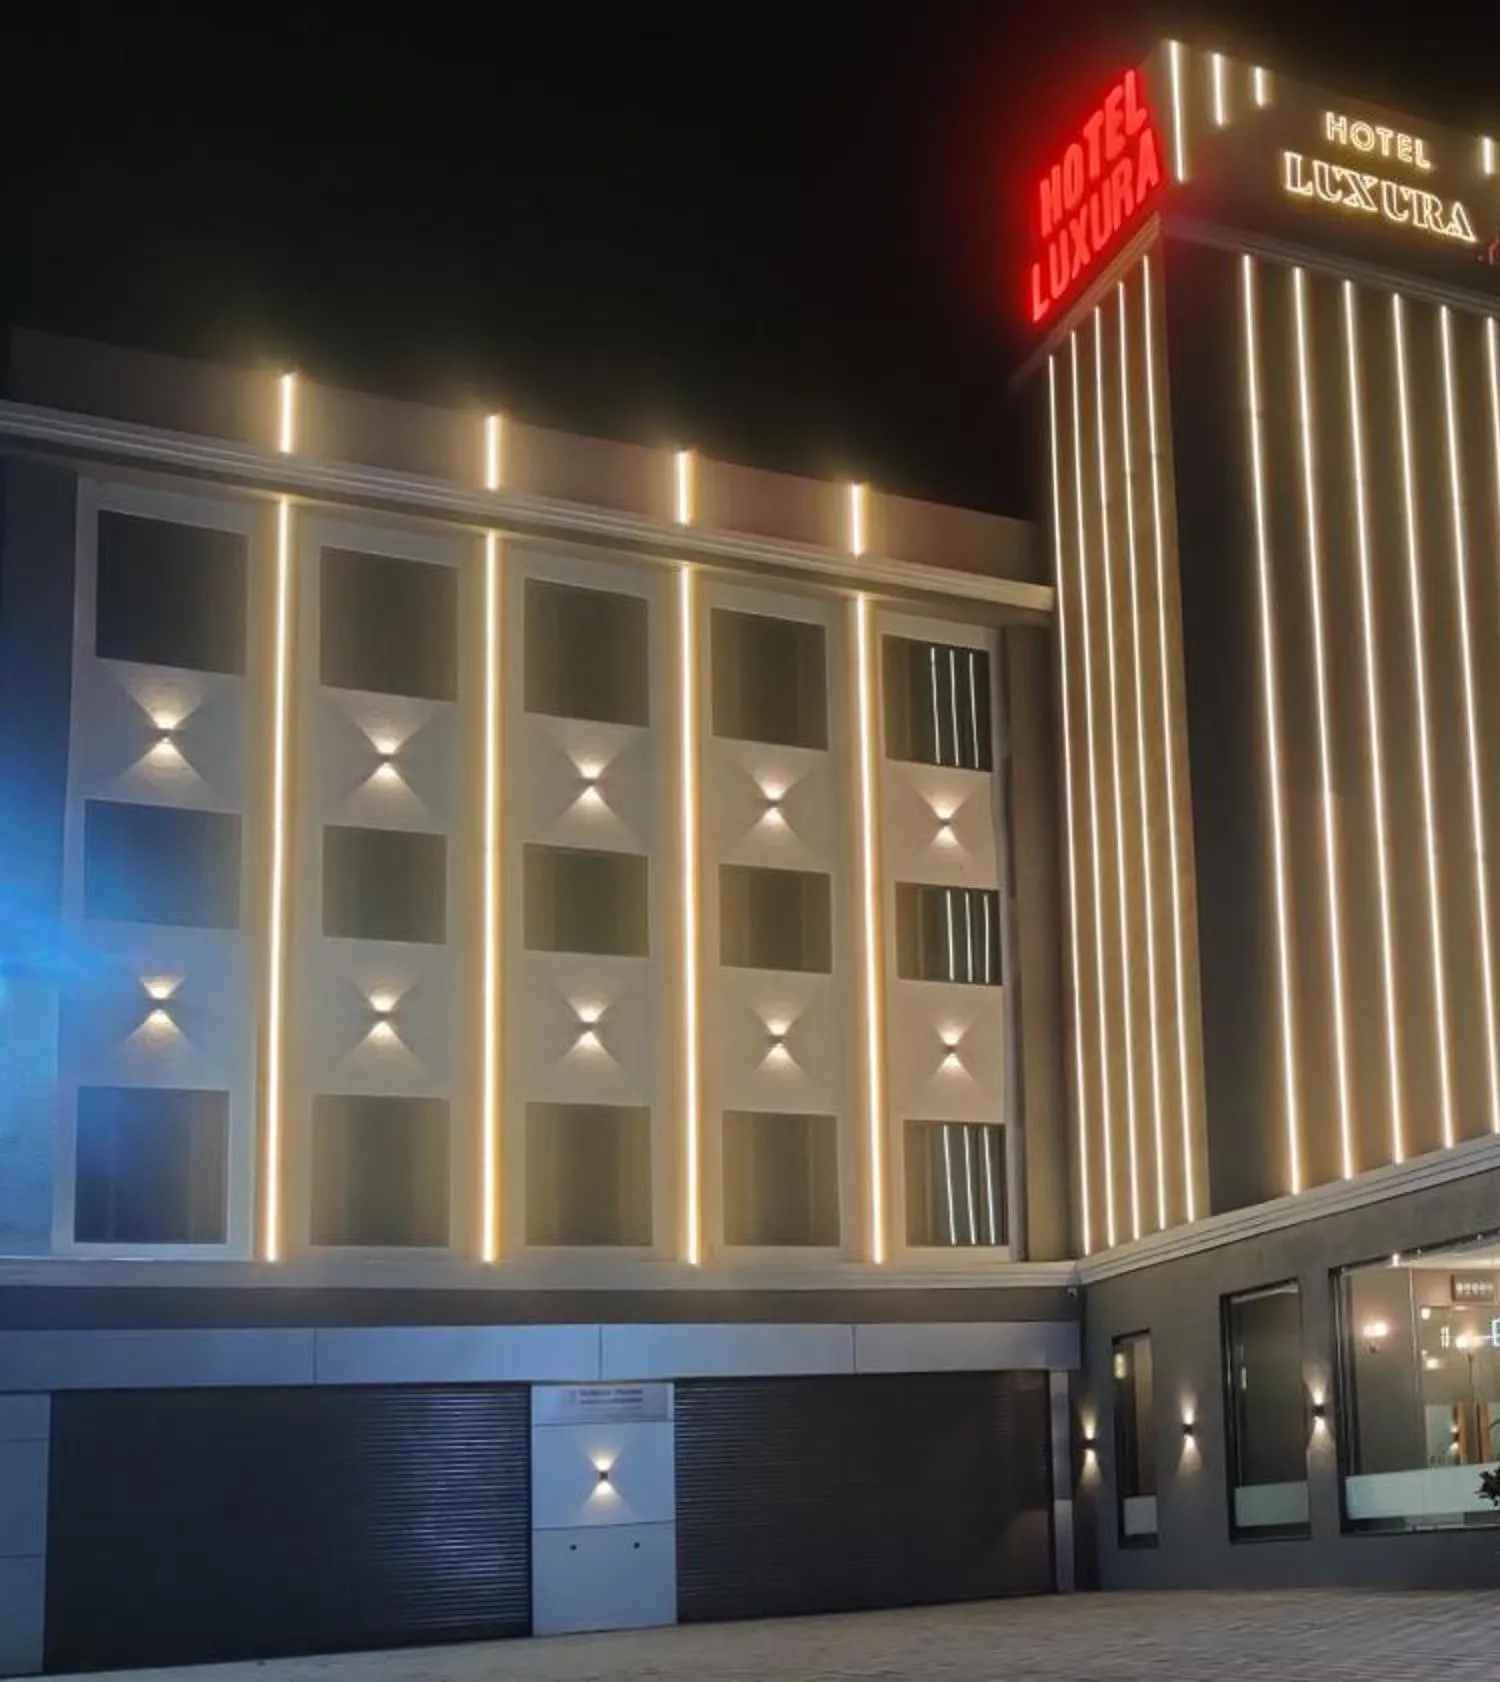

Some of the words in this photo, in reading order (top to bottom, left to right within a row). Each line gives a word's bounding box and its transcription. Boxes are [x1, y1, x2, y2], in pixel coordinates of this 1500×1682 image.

[1040, 69, 1147, 239] HOTEL
[1284, 151, 1477, 242] LUXURA
[1325, 111, 1431, 169] HOTEL
[1032, 128, 1159, 324] LUXURA
